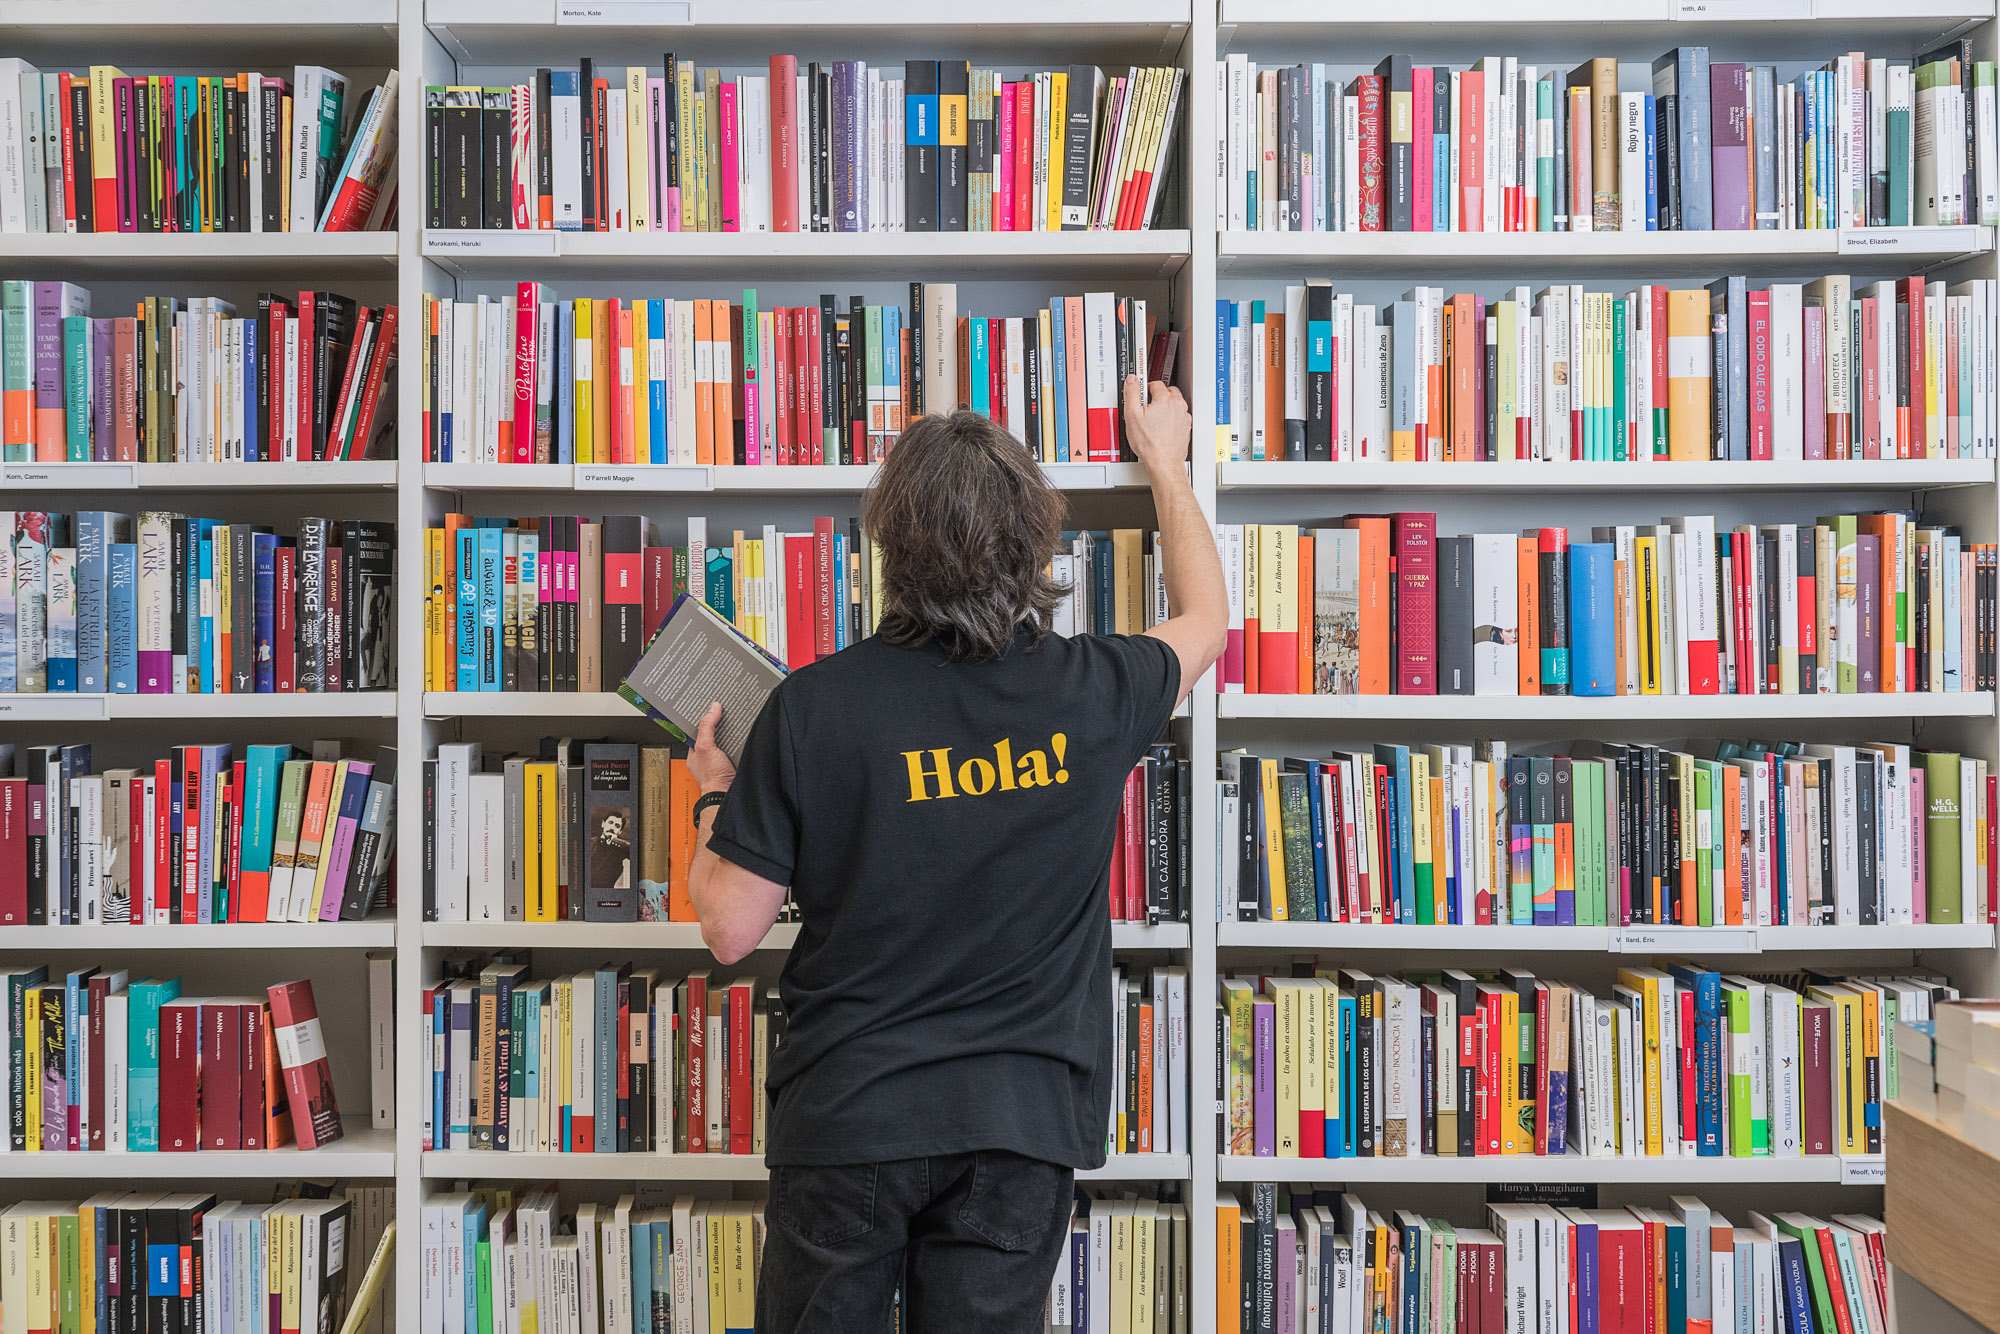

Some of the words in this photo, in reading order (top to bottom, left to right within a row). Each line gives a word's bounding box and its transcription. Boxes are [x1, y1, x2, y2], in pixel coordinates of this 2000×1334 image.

[1628, 102, 1638, 126] negro
[300, 126, 308, 150] Khadra
[1005, 124, 1011, 132] de
[1627, 135, 1638, 152] Rojo
[299, 152, 308, 179] Yasmina
[1756, 320, 1765, 332] EL
[1756, 336, 1765, 361] ODIO
[515, 336, 535, 400] Portofino
[1756, 365, 1766, 387] QUE
[1379, 400, 1387, 409] La
[1756, 391, 1765, 412] DAS
[79, 522, 92, 562] LARK
[305, 525, 318, 546] D.H.
[691, 541, 703, 569] PERDIDOS
[91, 578, 99, 594] LA
[302, 550, 318, 611] LAWRENCE
[691, 573, 703, 597] OBJETOS
[821, 574, 828, 582] DE
[91, 598, 100, 660] ESTRELLA
[900, 732, 1069, 802] Hola!
[188, 771, 197, 786] LEVY
[188, 789, 197, 809] MARC
[186, 826, 197, 849] NOCHE
[186, 851, 196, 860] DE
[1159, 820, 1168, 882] CAZADORA
[185, 862, 196, 893] OCURRIÓ
[1160, 888, 1168, 899] LA
[13, 984, 22, 1002] maley
[13, 1006, 22, 1038] jacqueline
[691, 1033, 702, 1047] Mi
[498, 1042, 508, 1080] Virtud
[13, 1067, 21, 1092] historia
[692, 1058, 701, 1087] Roberts
[499, 1082, 508, 1091] &
[498, 1095, 507, 1128] Amor
[692, 1089, 701, 1115] Bethan
[14, 1111, 22, 1126] solo
[1712, 1115, 1717, 1123] DE
[1534, 1182, 1585, 1194] Yanagihara
[1516, 1287, 1526, 1309] Wright
[1796, 1286, 1804, 1308] ASAKO
